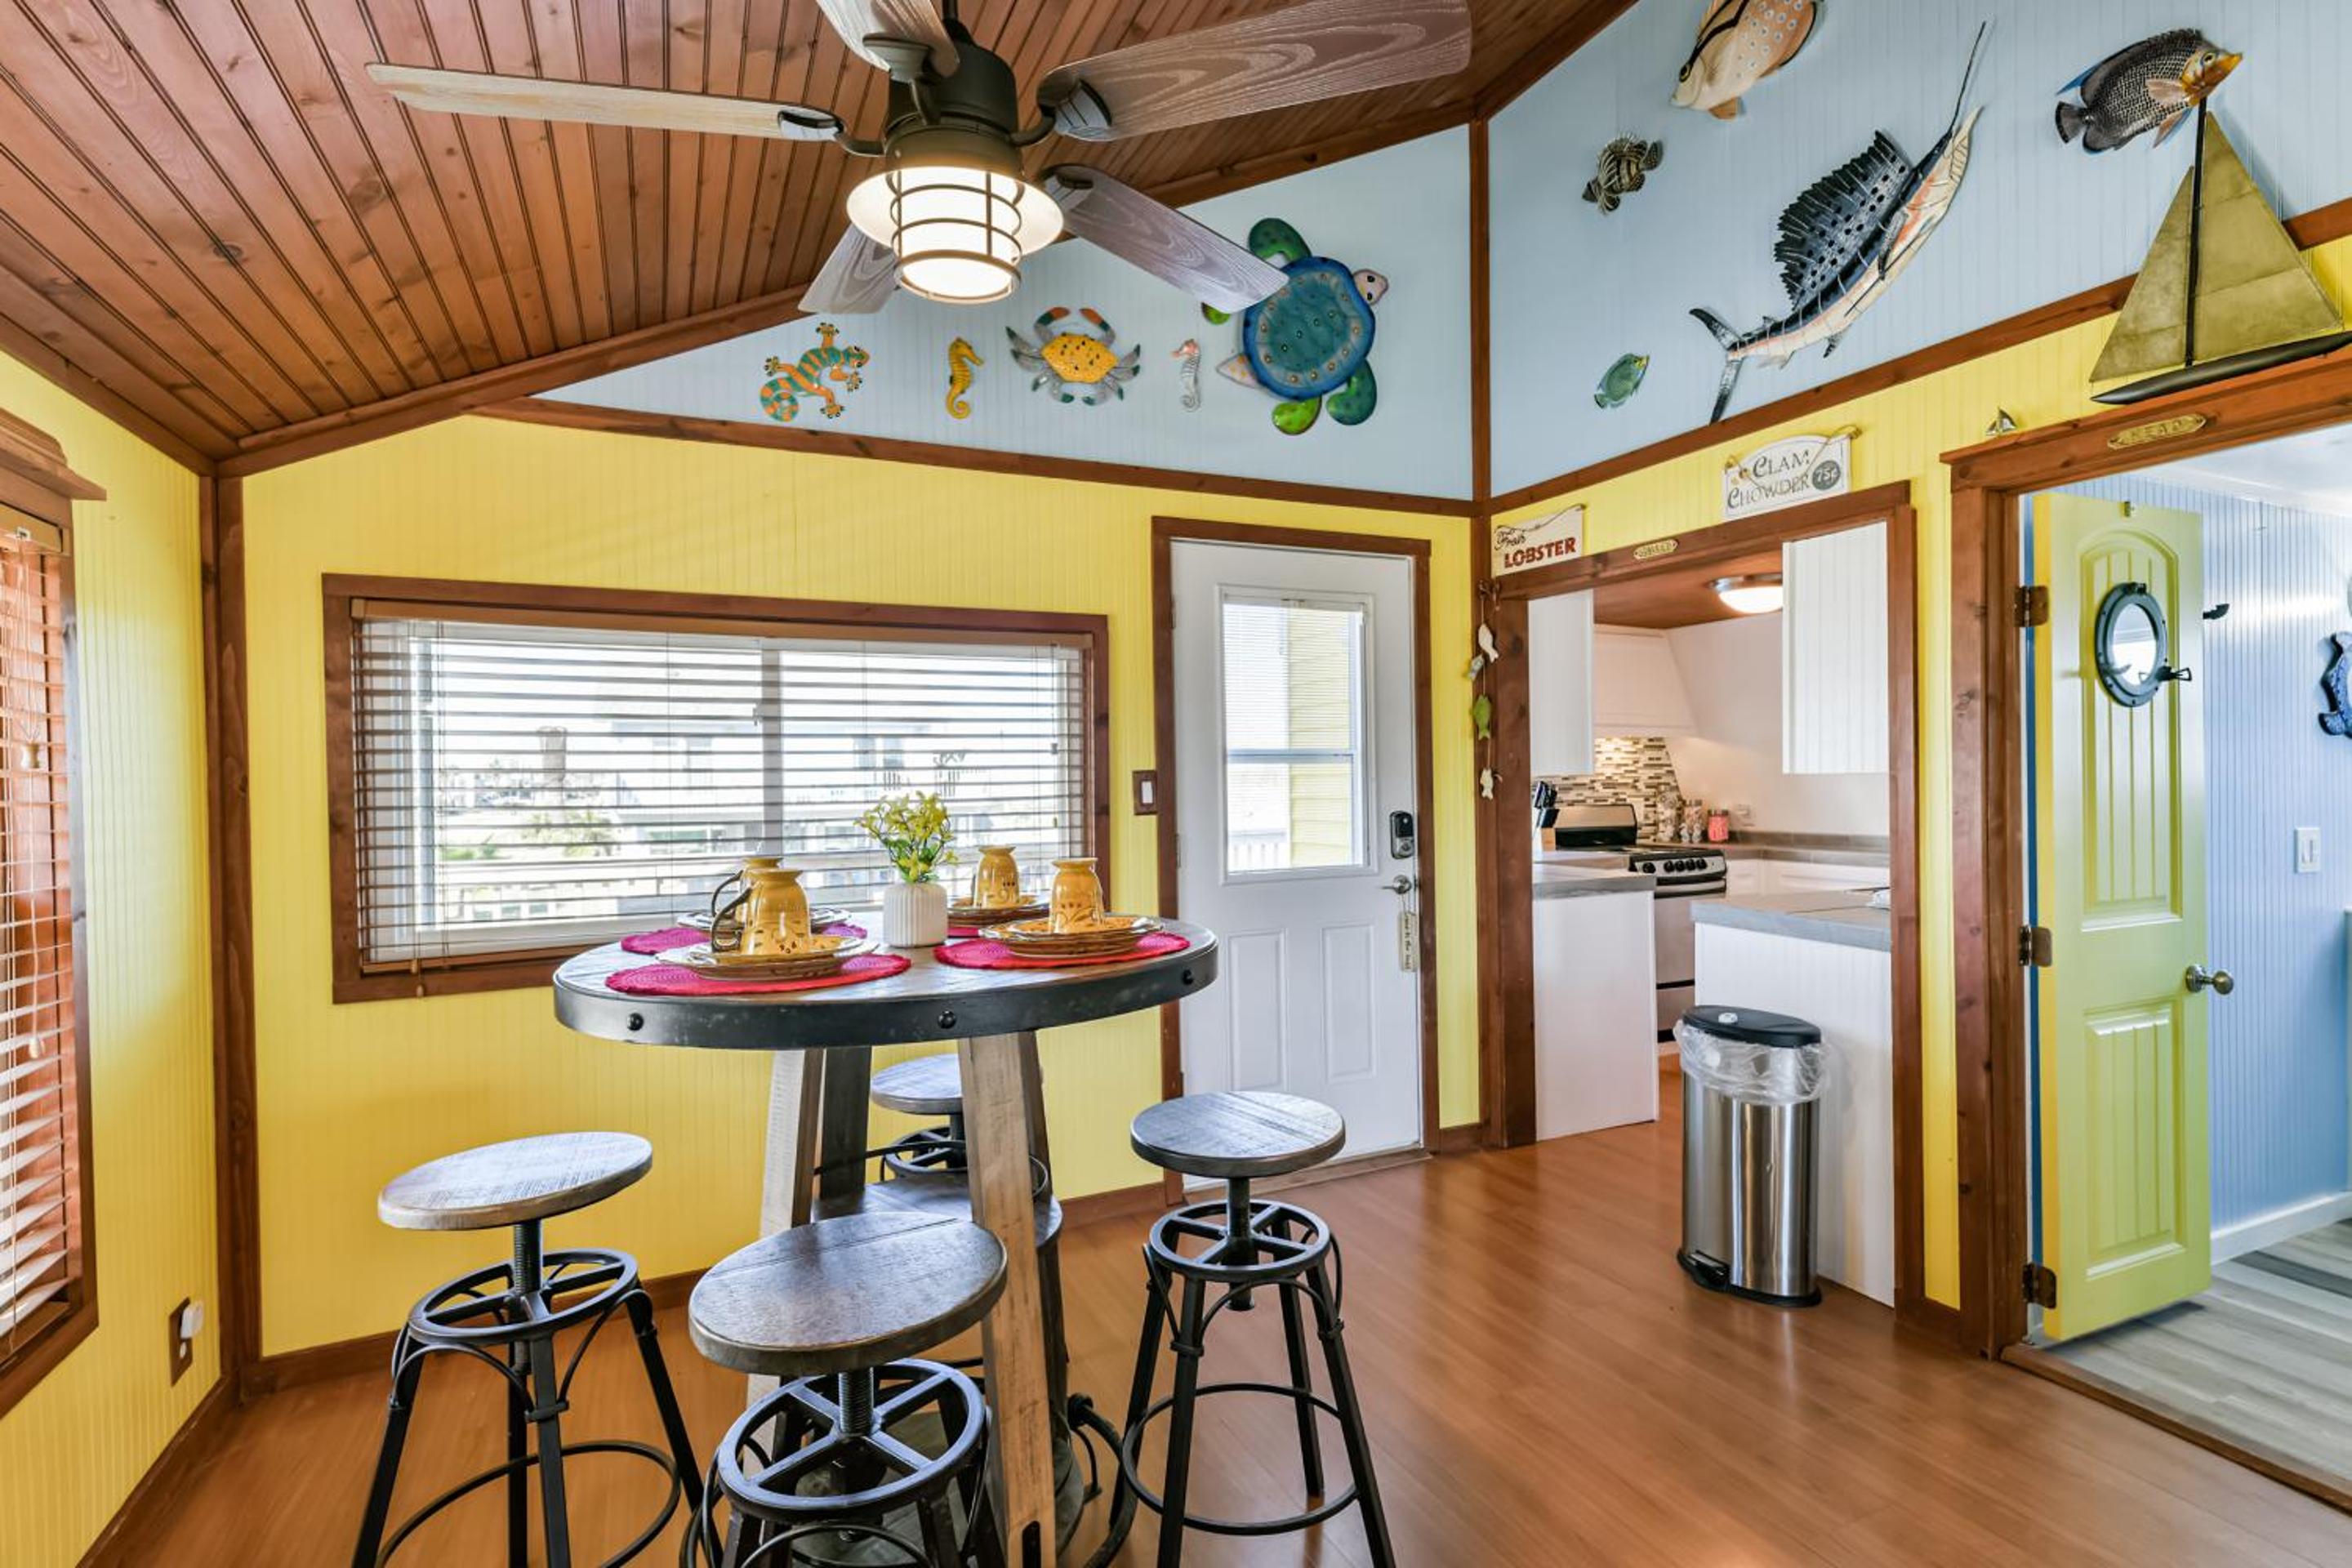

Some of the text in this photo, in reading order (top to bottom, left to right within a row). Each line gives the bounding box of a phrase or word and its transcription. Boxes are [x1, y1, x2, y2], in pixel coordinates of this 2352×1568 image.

[1753, 450, 1810, 478] CLAM
[1727, 474, 1810, 509] CHOWDER
[1504, 537, 1576, 568] LOBSTER
